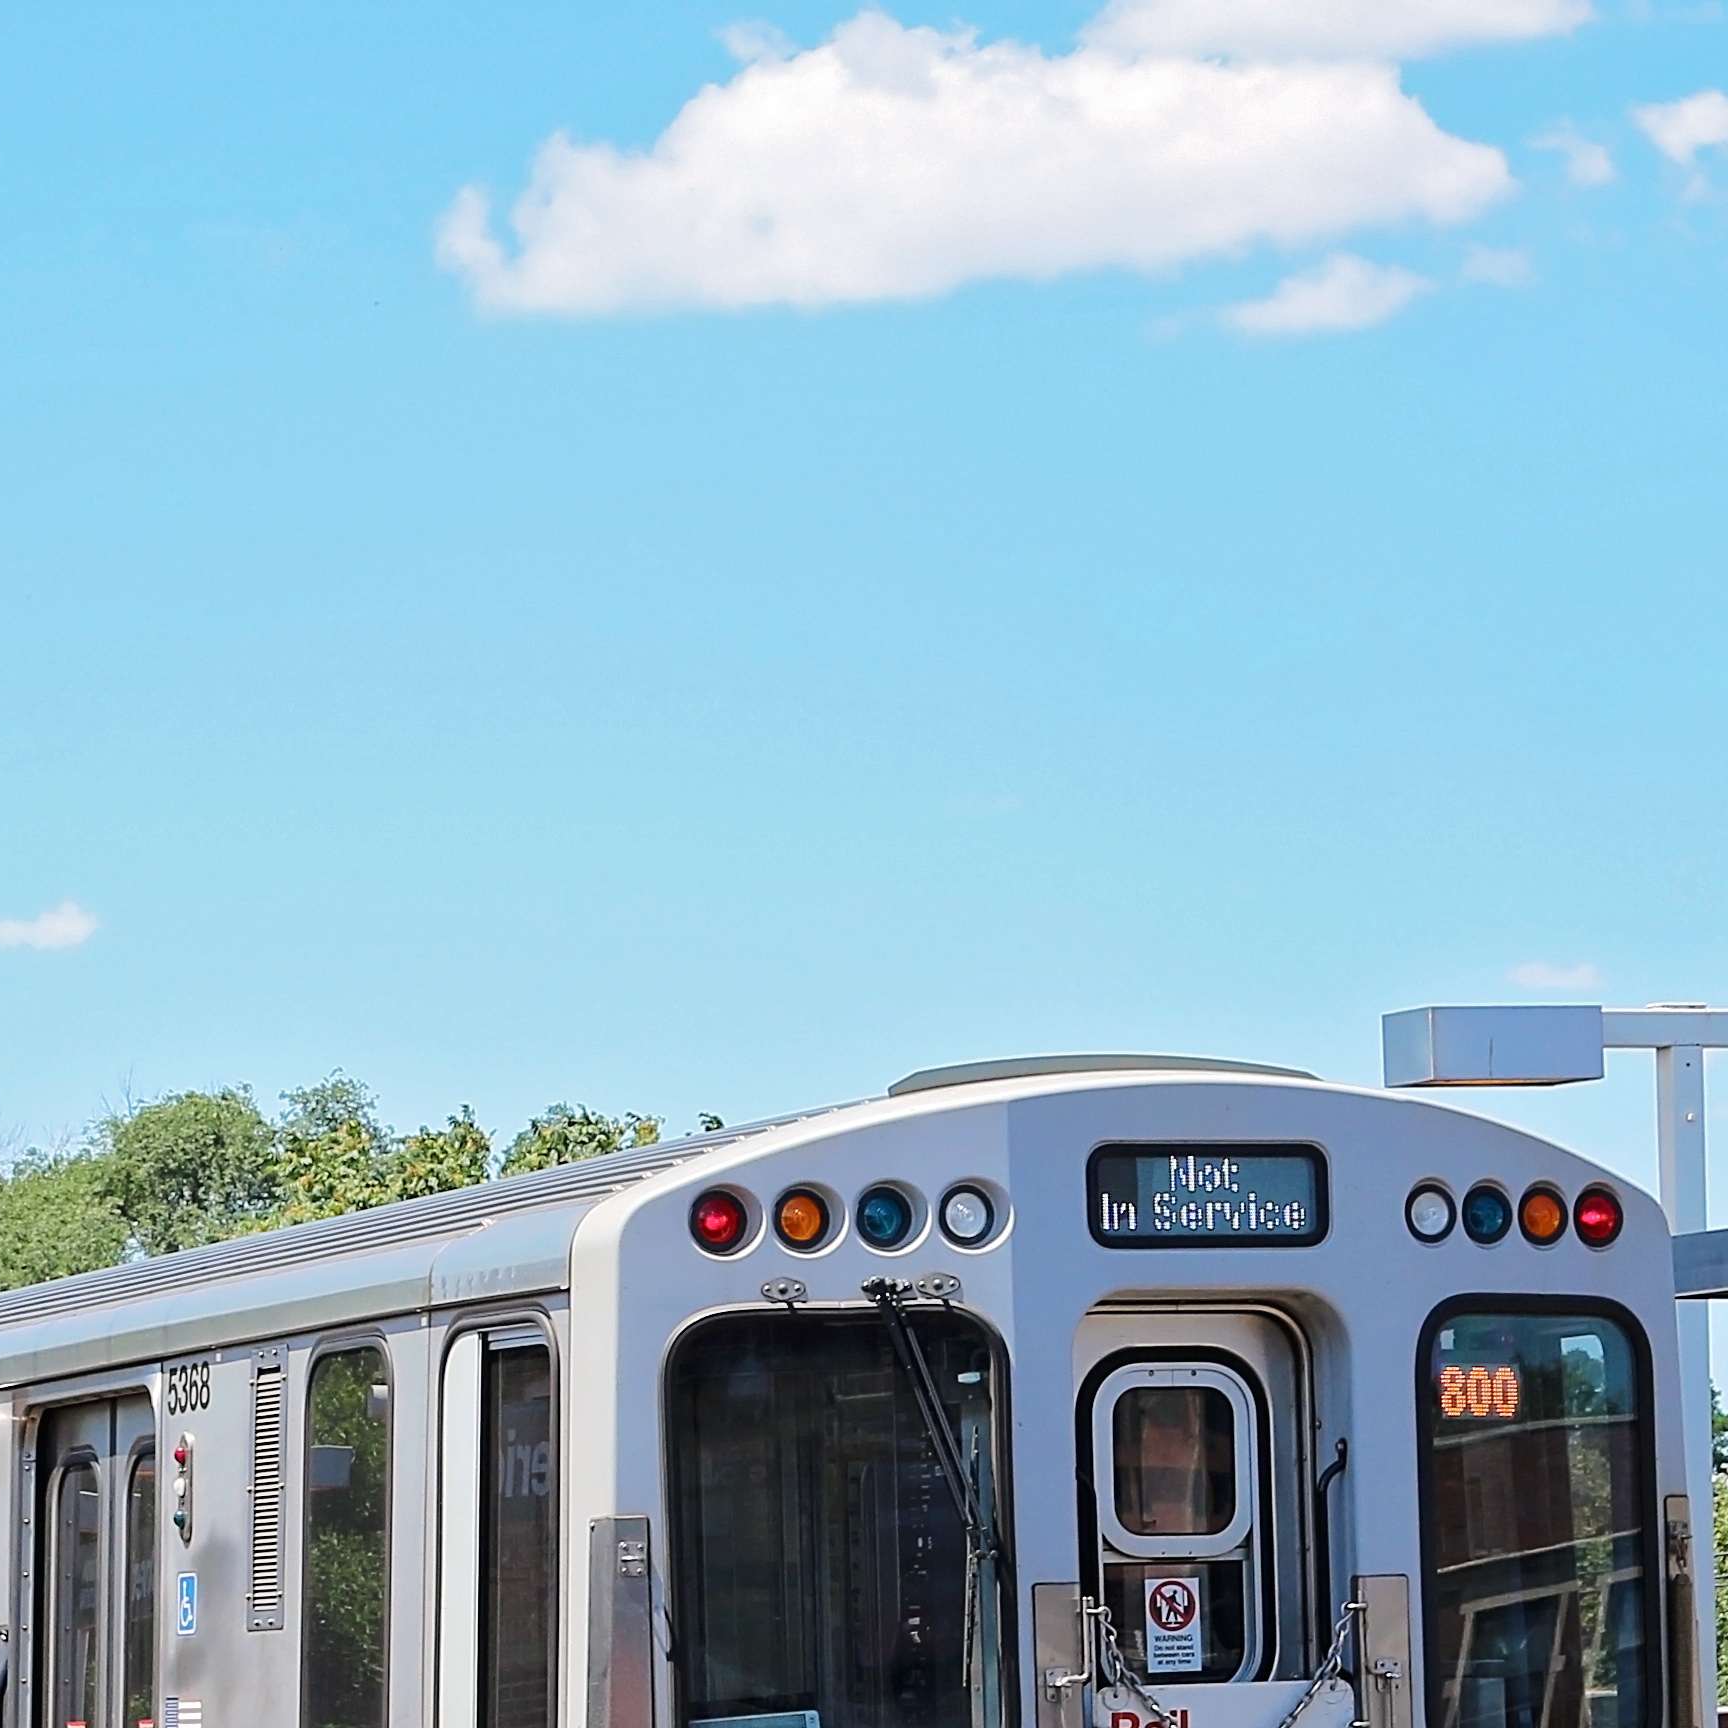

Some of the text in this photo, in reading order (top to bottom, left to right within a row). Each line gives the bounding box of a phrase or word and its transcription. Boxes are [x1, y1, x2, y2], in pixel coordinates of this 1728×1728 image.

[1170, 1155, 1239, 1192] Not
[1101, 1192, 1306, 1231] In Service
[167, 1360, 210, 1416] 5368
[1440, 1366, 1519, 1417] 800
[1154, 1634, 1193, 1642] WARNING
